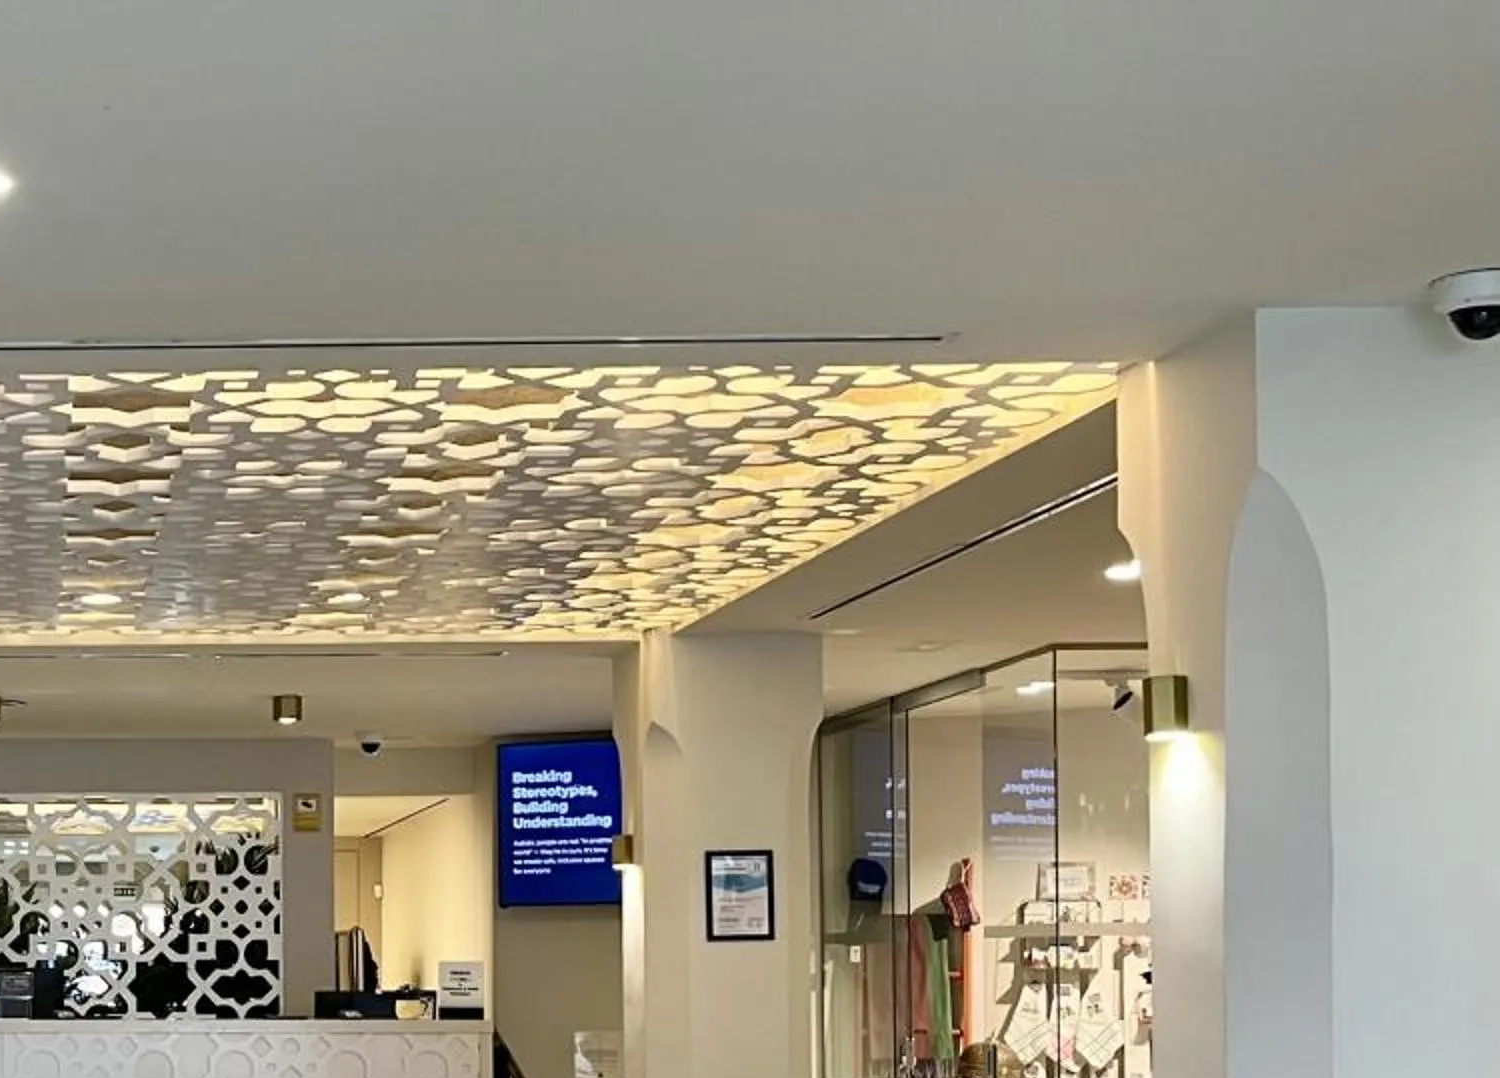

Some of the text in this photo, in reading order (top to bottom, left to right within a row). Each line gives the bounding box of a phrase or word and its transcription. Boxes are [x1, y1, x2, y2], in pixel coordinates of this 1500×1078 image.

[513, 770, 572, 784] Breaking
[513, 785, 598, 799] Stereotypes,
[513, 800, 569, 814] Building
[513, 814, 612, 828] Understanding
